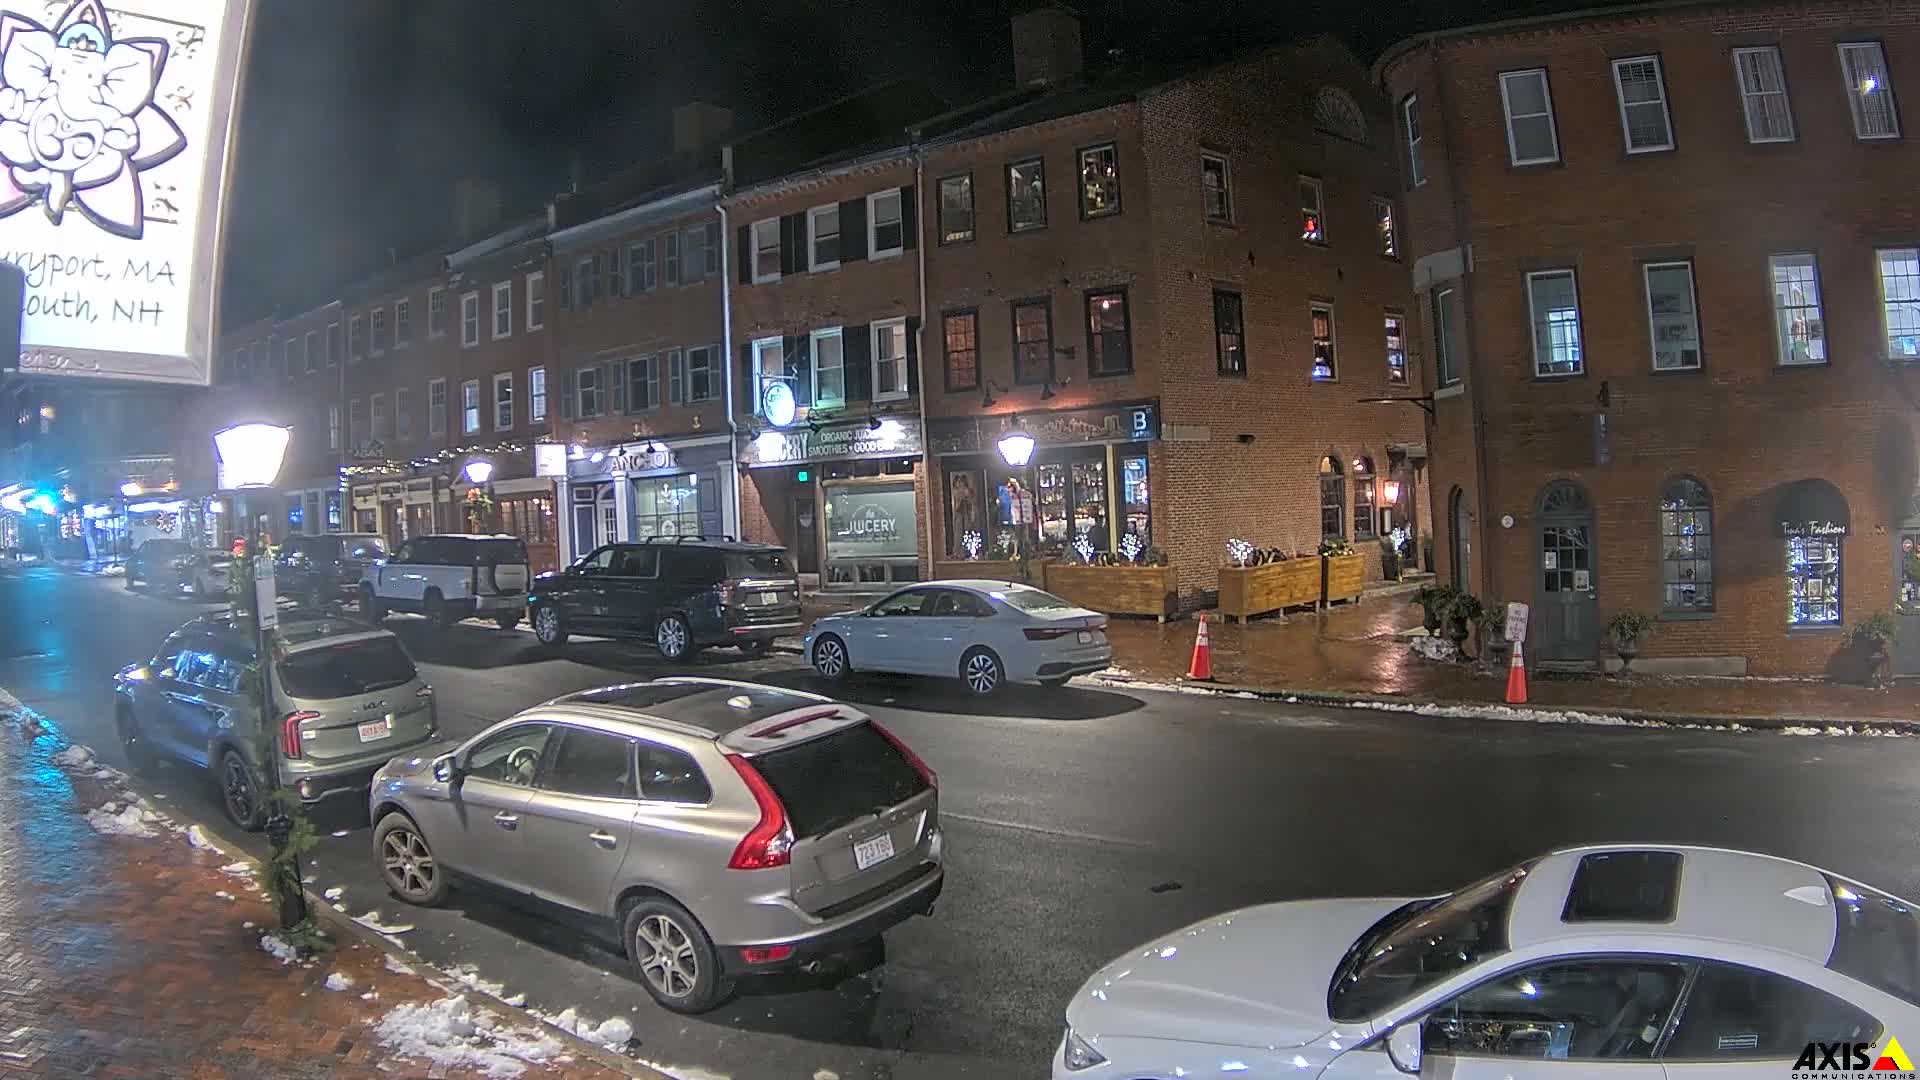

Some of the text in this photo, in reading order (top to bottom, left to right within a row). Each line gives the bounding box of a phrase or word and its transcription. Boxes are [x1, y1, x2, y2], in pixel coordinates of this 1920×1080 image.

[123, 258, 176, 286] MA
[22, 289, 164, 326] outh, NH
[808, 443, 848, 457] SMOOTHIES
